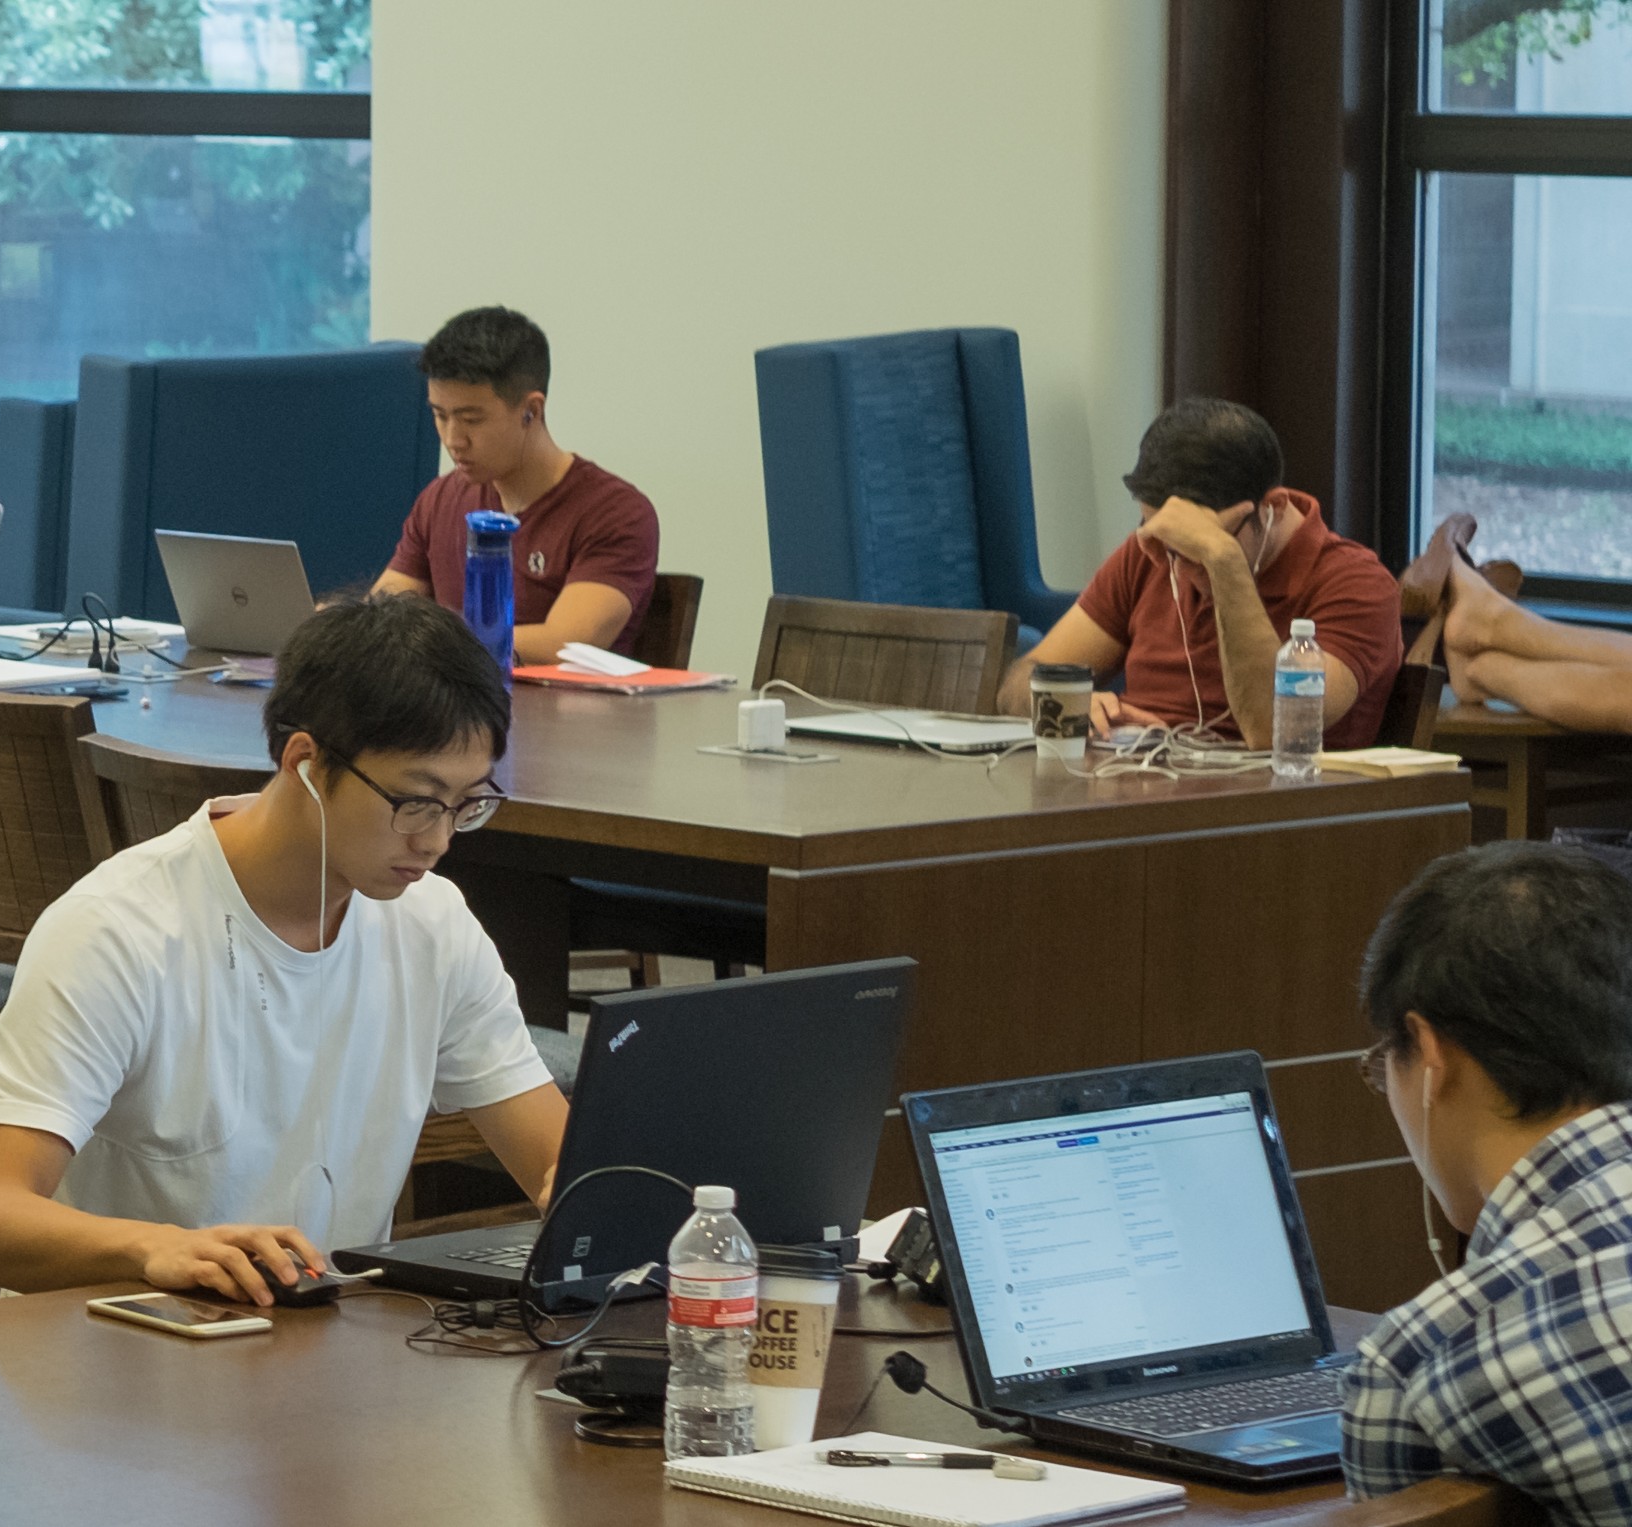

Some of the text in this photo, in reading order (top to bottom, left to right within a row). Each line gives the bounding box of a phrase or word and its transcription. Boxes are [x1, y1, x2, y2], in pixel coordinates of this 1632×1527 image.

[756, 1307, 798, 1334] ICE
[753, 1337, 797, 1352] OFFEE
[749, 1353, 797, 1370] OUSE
